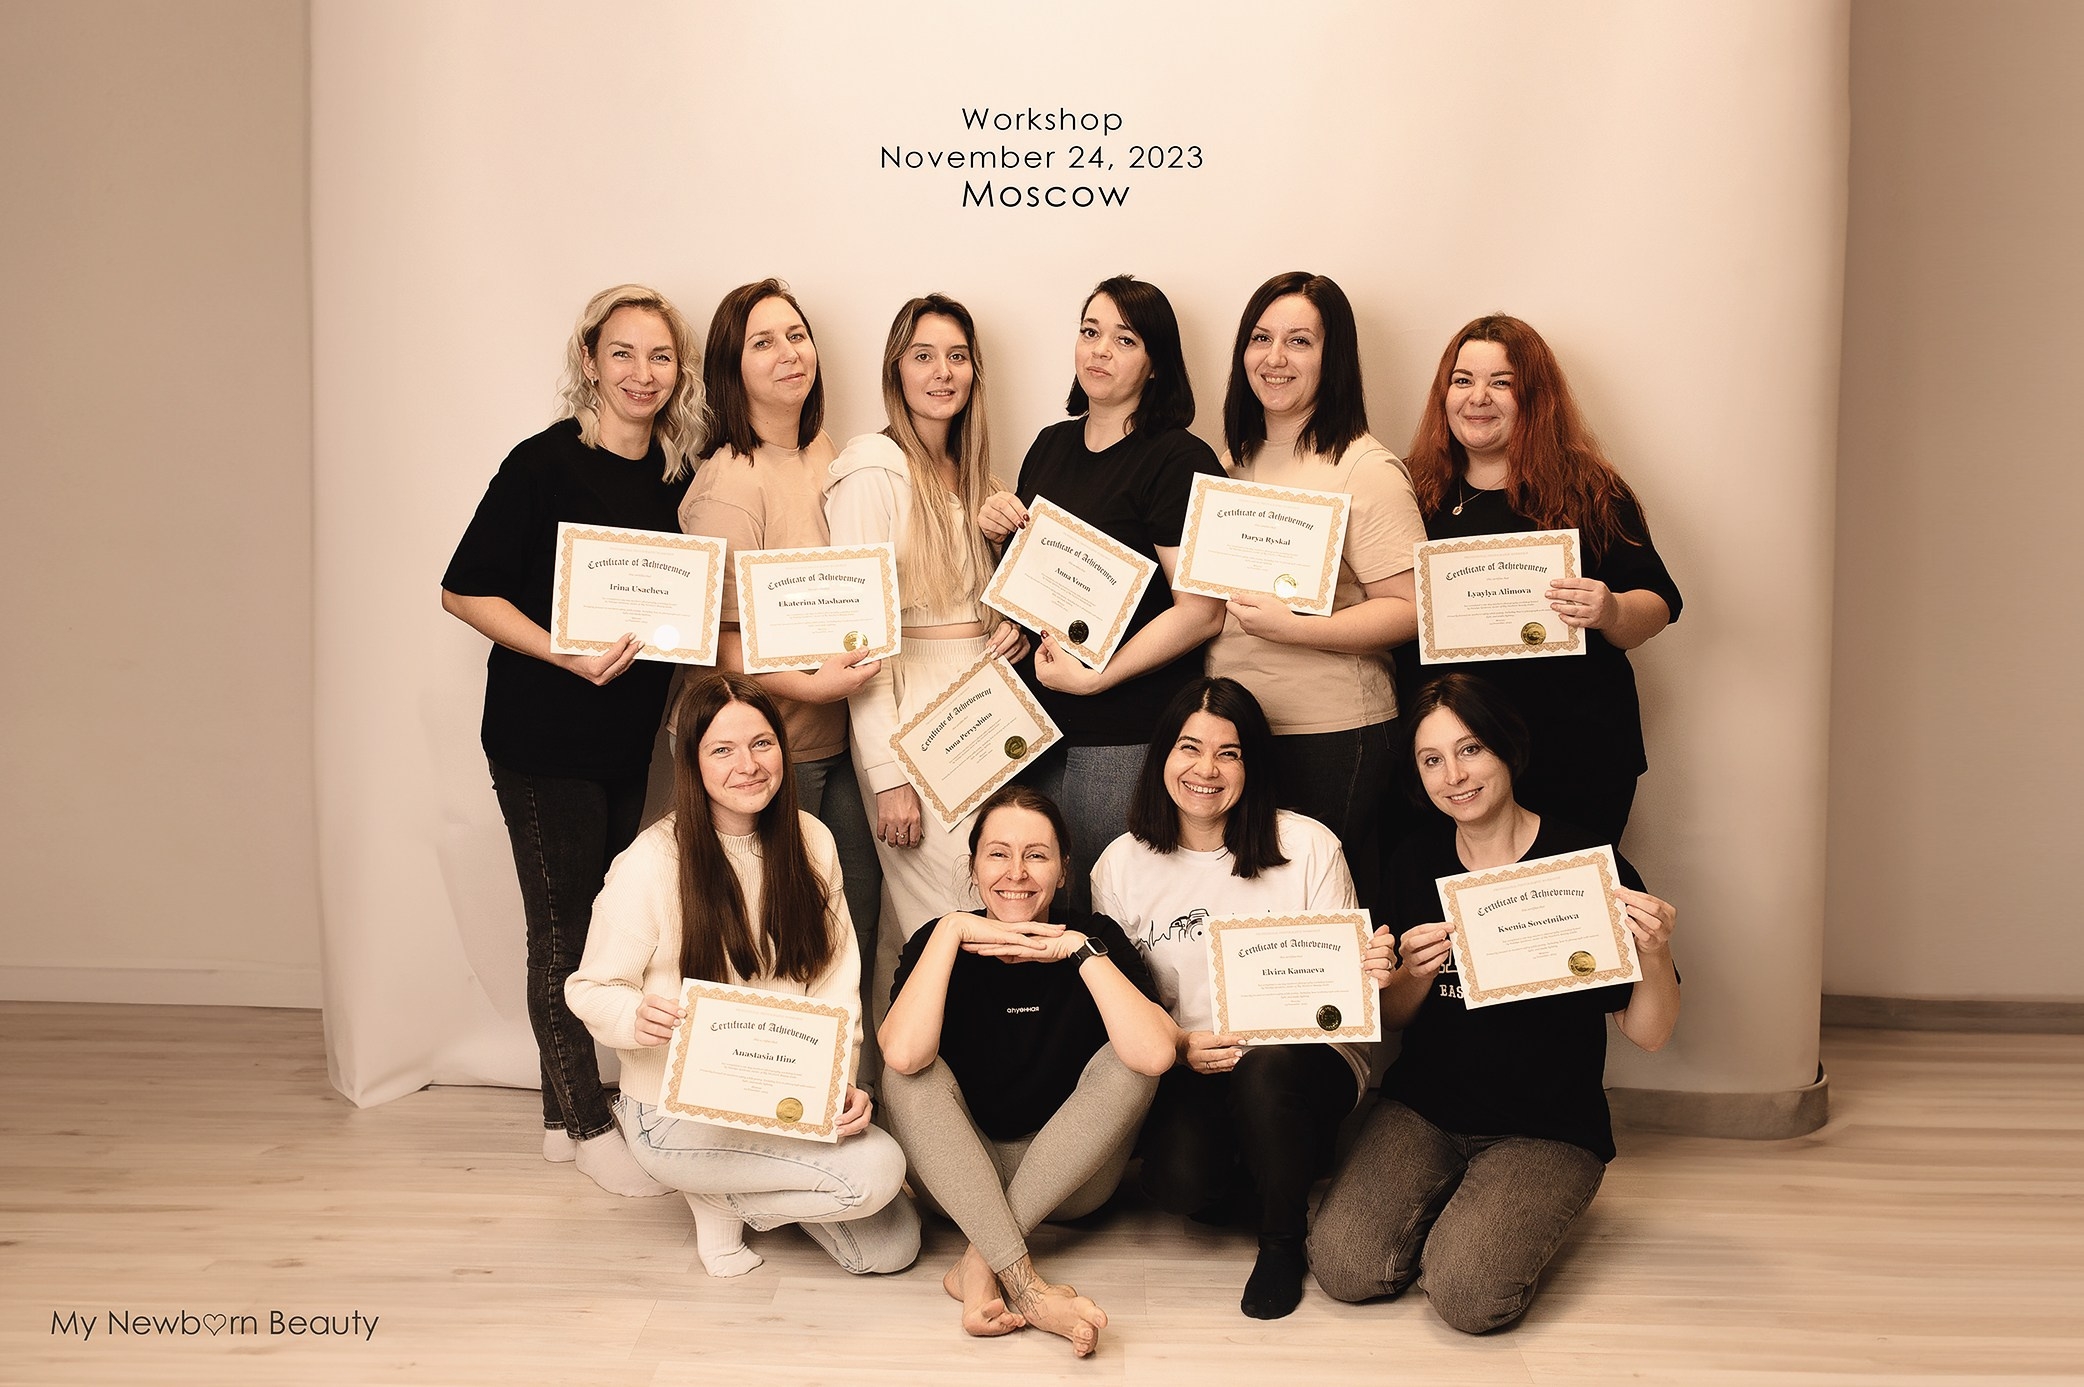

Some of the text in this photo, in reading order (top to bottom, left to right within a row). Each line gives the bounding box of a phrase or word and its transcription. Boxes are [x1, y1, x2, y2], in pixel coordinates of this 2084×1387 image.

[1217, 508, 1256, 519] Certificate
[1268, 511, 1314, 531] Achievement
[1241, 533, 1291, 546] Darya Ryskal
[587, 558, 629, 569] Certificate
[632, 558, 639, 566] of
[642, 558, 691, 578] Achievement
[1041, 537, 1074, 554] Certificate
[1082, 554, 1117, 586] Achievement
[1055, 567, 1071, 581] Anna
[1071, 576, 1091, 592] Voron
[1446, 565, 1485, 581] Certificate
[1498, 562, 1548, 573] Achievement
[610, 583, 669, 595] Irina Usacheva
[768, 576, 806, 590] Certificate
[818, 573, 866, 585] Achievement
[1467, 589, 1497, 598] Lyaylya
[921, 719, 947, 752] Certificate
[947, 713, 954, 721] of
[952, 688, 992, 716] Achievement
[945, 739, 961, 755] Anna
[1477, 896, 1518, 917] Certificate
[1520, 892, 1529, 902] of
[1530, 889, 1585, 899] Achievement
[1498, 912, 1579, 933] Ksenia Sovetnikova
[1238, 939, 1341, 958] Certificate of Achievement
[1262, 967, 1325, 976] Elvira Kamaeva
[710, 1020, 755, 1032] Certificate
[757, 1022, 766, 1031] of
[768, 1022, 819, 1046] Achievement
[732, 1048, 797, 1064] Anastasia Hinz
